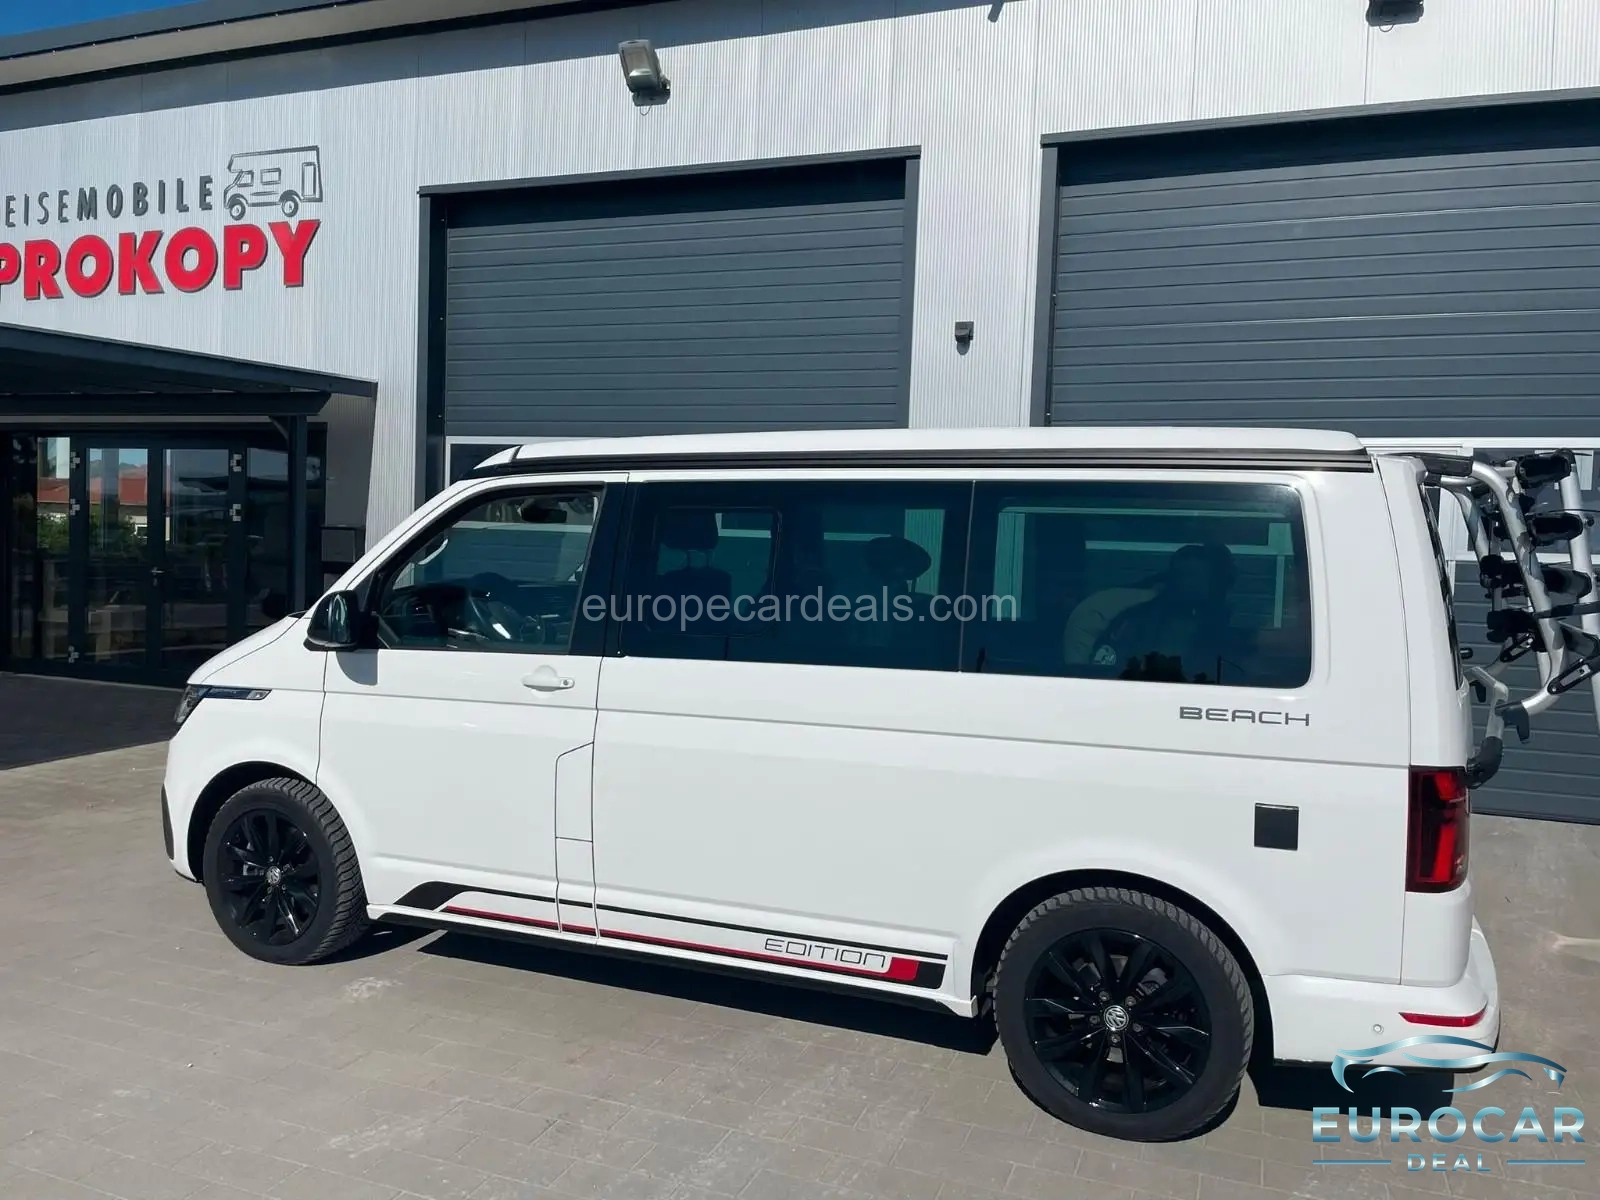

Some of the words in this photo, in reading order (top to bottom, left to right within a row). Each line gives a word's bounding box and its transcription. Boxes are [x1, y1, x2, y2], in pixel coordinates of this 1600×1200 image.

[5, 175, 213, 228] EISEMOBILE
[0, 219, 321, 301] PROKOPY
[1179, 706, 1310, 726] BEACH
[764, 938, 886, 968] EDITION
